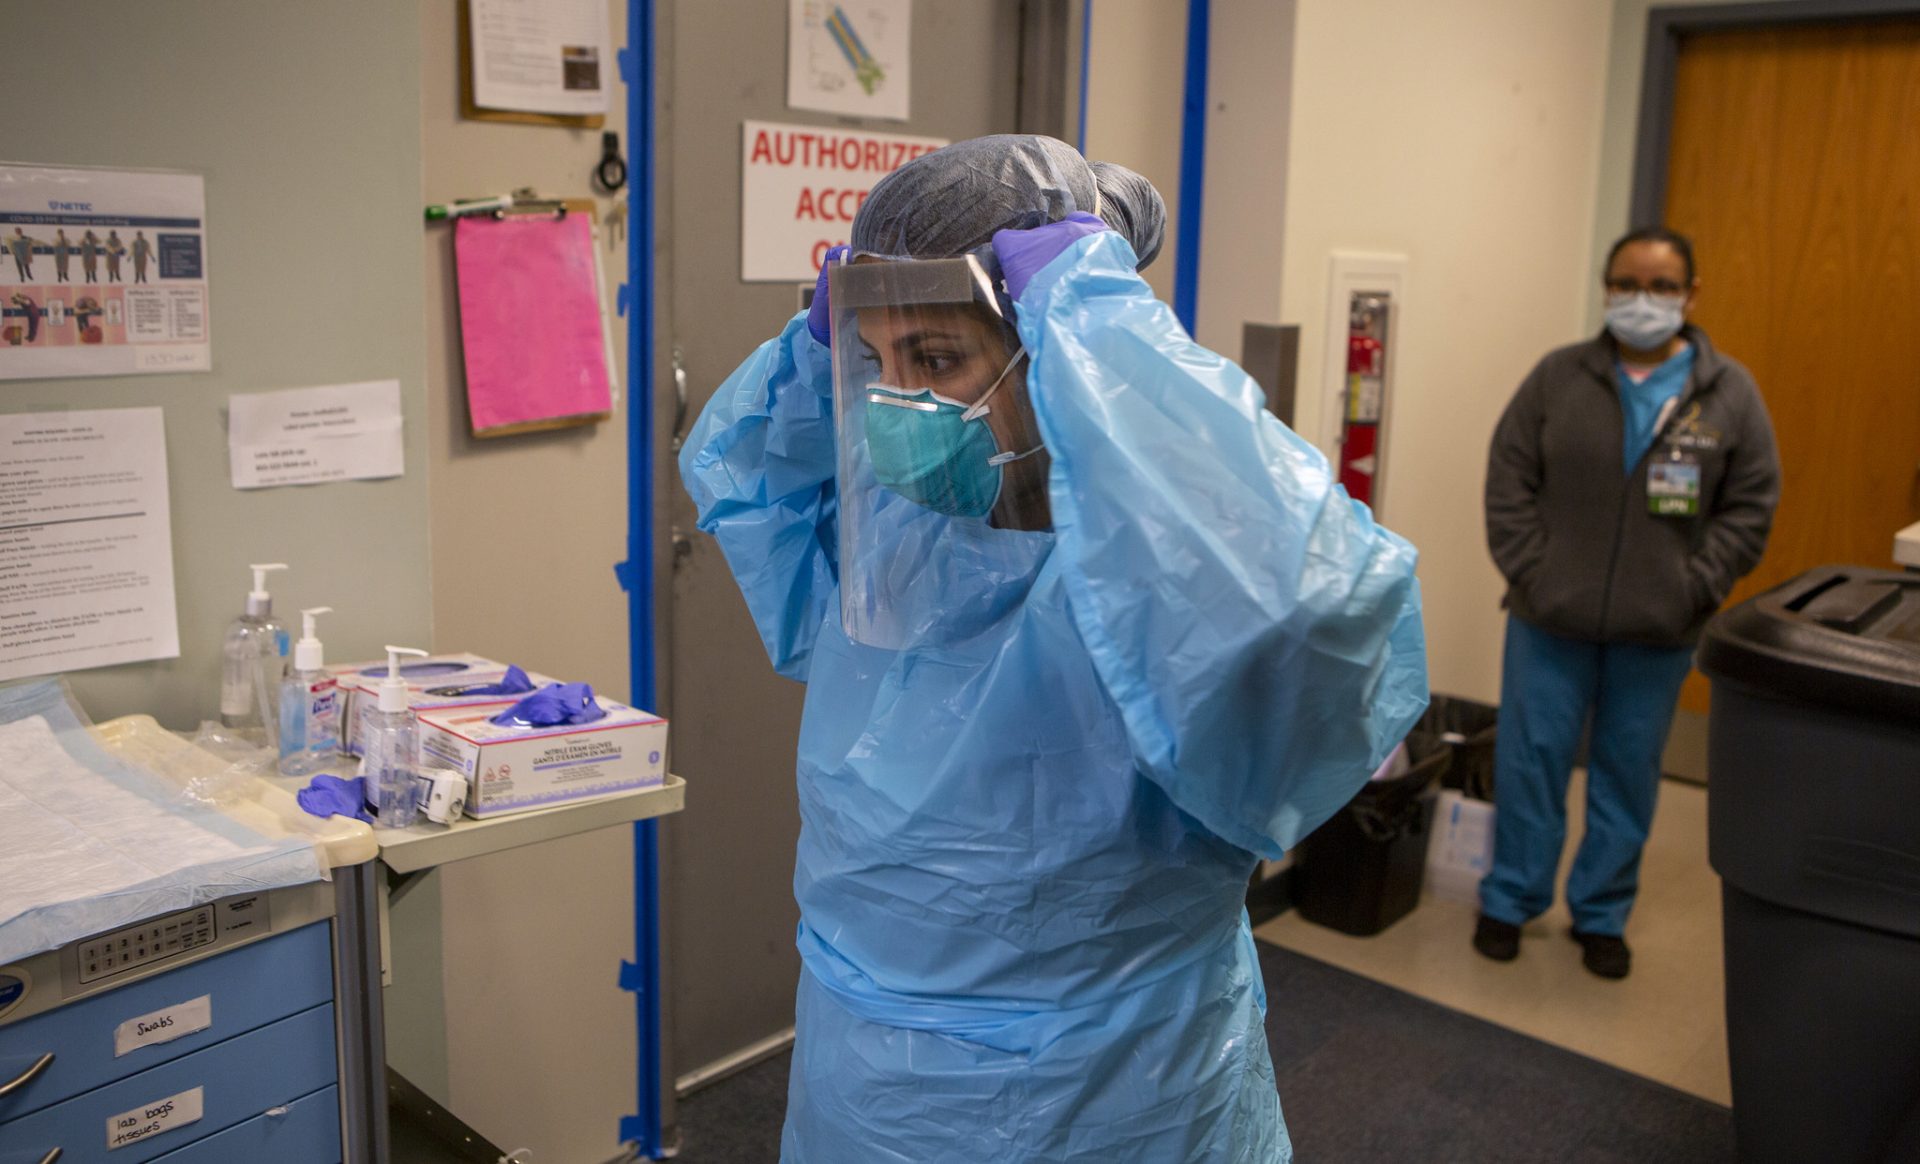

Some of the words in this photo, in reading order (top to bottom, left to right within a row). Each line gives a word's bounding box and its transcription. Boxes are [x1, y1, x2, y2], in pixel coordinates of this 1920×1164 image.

[751, 130, 938, 172] AUTHORIZE
[60, 201, 93, 212] NETEC
[795, 187, 869, 222] ACCE
[532, 756, 554, 765] GANTS
[555, 751, 588, 762] D'EXAMEN
[600, 745, 622, 755] NITRILE
[544, 747, 568, 756] NITRILE
[569, 744, 587, 753] EXAM
[588, 740, 612, 750] GLOVES
[145, 1100, 174, 1119] bags
[112, 1120, 161, 1145] tissues
